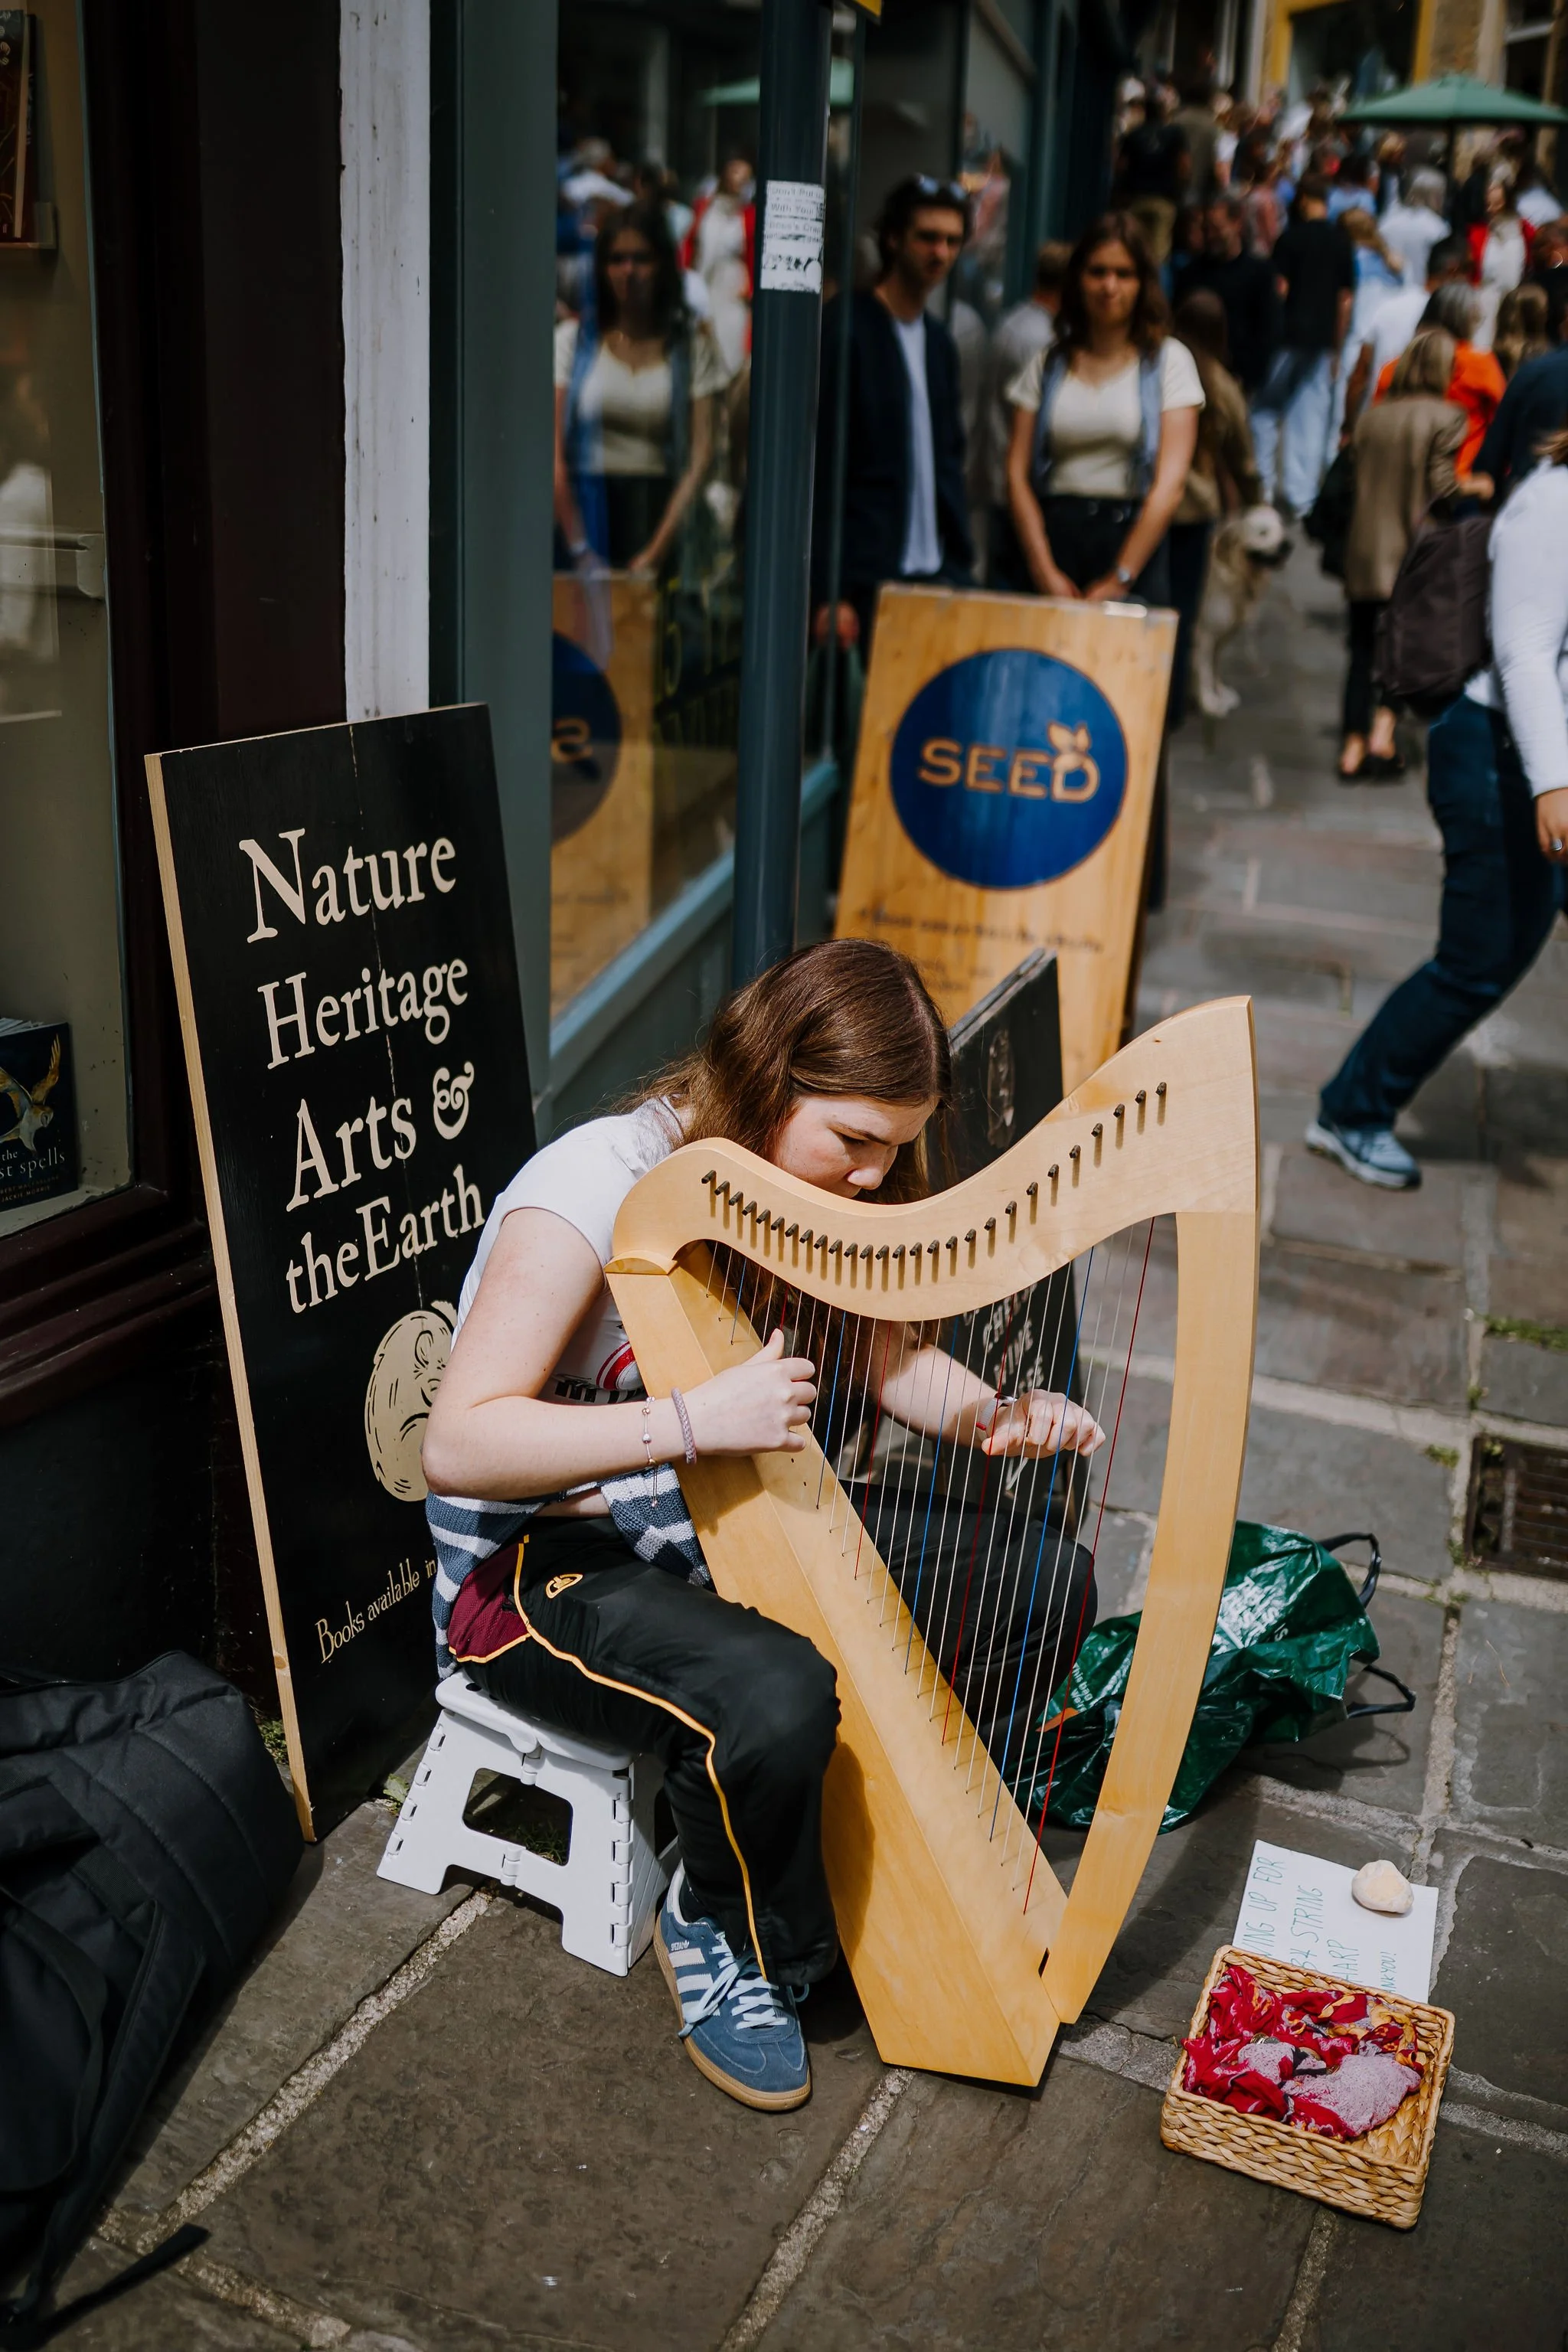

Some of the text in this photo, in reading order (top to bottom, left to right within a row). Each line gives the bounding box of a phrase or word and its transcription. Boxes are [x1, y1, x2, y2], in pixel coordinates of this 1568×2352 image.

[918, 737, 1100, 803] SEED
[239, 828, 456, 943] Nature
[257, 959, 468, 1069] Heritage
[2, 1149, 18, 1161] the
[20, 1146, 65, 1178] spells
[286, 1061, 475, 1212] Arts &
[315, 1558, 436, 1664] Books available in
[1078, 1681, 1093, 1701] bag
[1242, 1857, 1288, 1957] VING UP FOR
[1291, 1885, 1324, 1942] STRING
[1326, 1939, 1363, 1983] HARP
